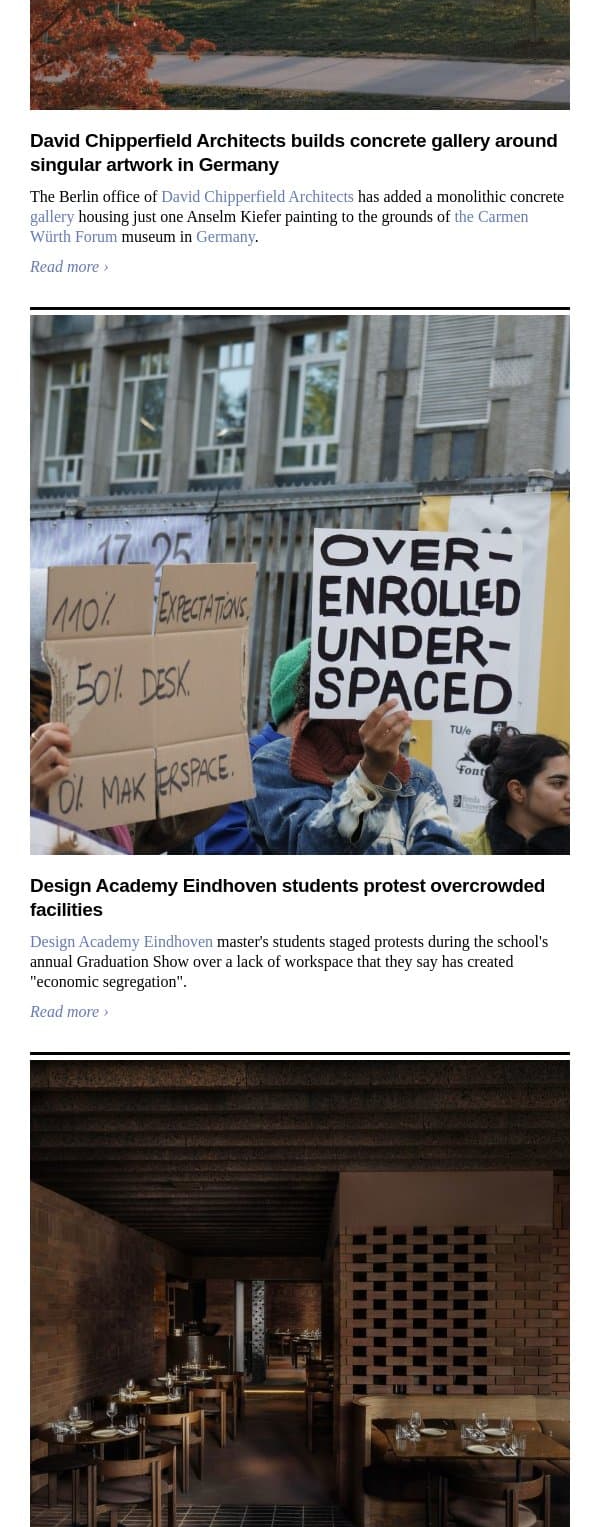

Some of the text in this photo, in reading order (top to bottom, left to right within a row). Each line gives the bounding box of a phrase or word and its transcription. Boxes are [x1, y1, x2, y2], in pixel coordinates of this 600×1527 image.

[30, 132, 558, 152] David Chipperfield Architects builds concrete gallery around
[30, 157, 281, 176] singular artwork in Germany
[29, 229, 259, 247] Würth Forum museum in Germany.
[320, 534, 513, 572] OVER-
[319, 575, 521, 617] ENROLLED
[52, 591, 116, 632] 110%
[317, 625, 511, 668] UNDER-
[76, 663, 123, 706] 50%
[314, 667, 513, 715] SPACED
[458, 764, 486, 777] Font
[58, 773, 84, 814] 0%
[30, 878, 545, 897] Design Academy Eindhoven students protest overcrowded
[29, 902, 104, 918] facilities
[30, 975, 187, 992] "economic segregation".
